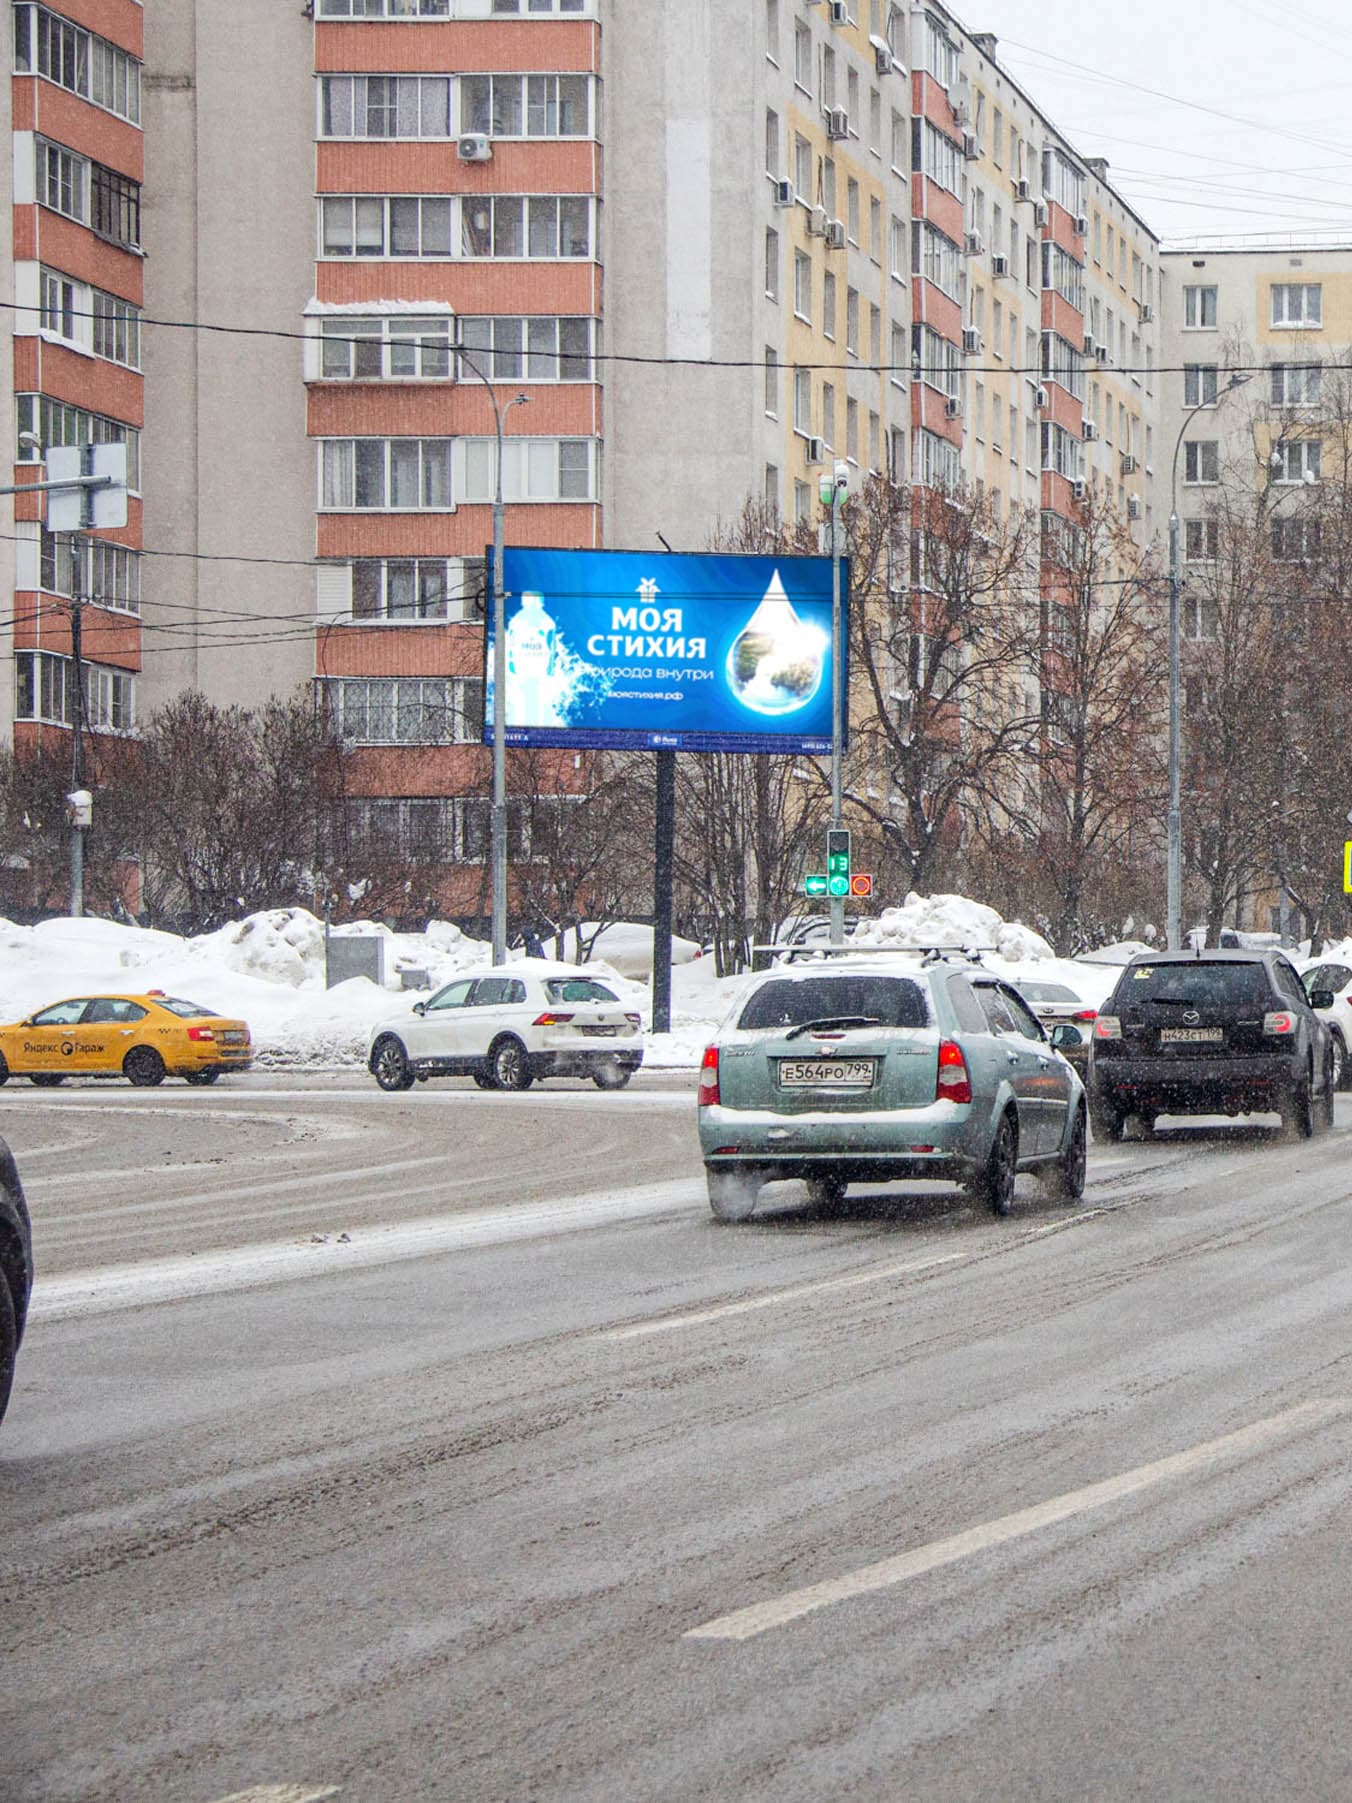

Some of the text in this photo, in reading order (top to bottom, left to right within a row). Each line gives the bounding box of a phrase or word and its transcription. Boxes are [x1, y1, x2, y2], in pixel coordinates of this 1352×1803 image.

[611, 607, 683, 632] МОЯ
[587, 634, 707, 659] СТИХИЯ
[656, 667, 714, 682] внутри
[829, 857, 848, 871] 13
[24, 1041, 105, 1054] Яндекс Гараж
